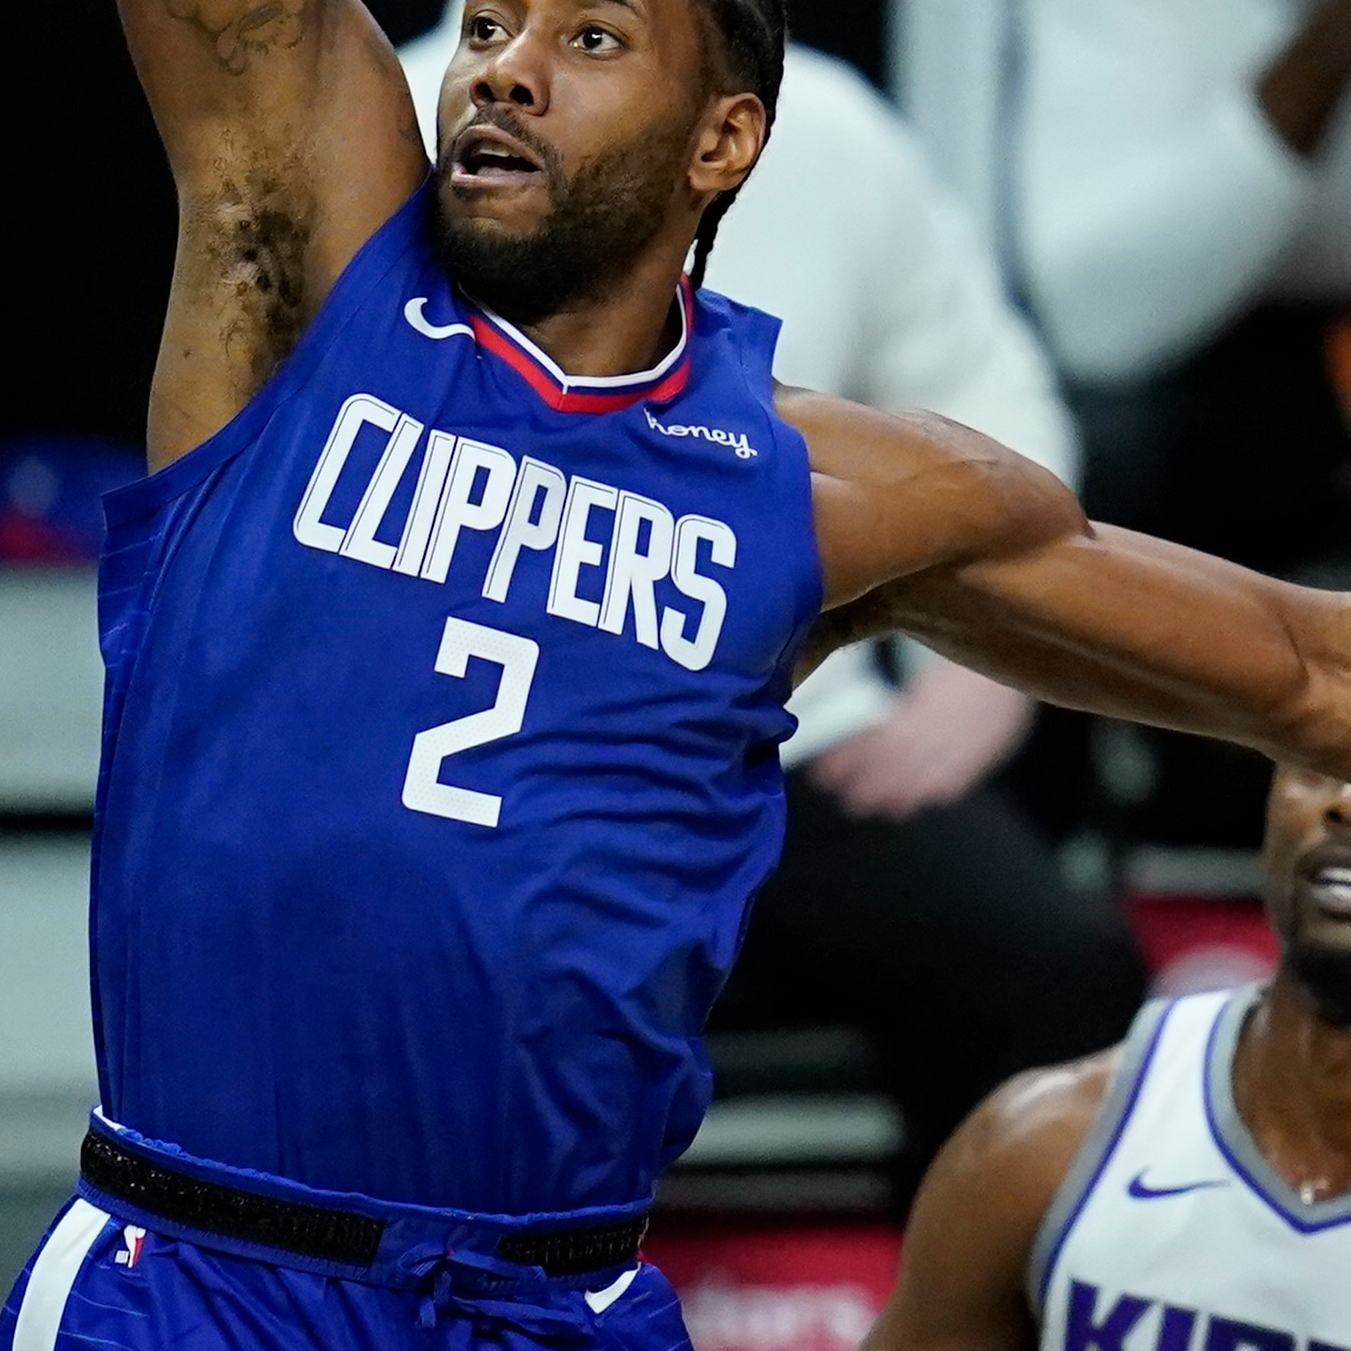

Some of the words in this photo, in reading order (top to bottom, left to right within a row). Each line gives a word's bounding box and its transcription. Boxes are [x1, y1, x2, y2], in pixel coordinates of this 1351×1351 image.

[292, 392, 737, 672] CLIPPERS
[642, 406, 758, 459] honey
[401, 615, 540, 828] 2
